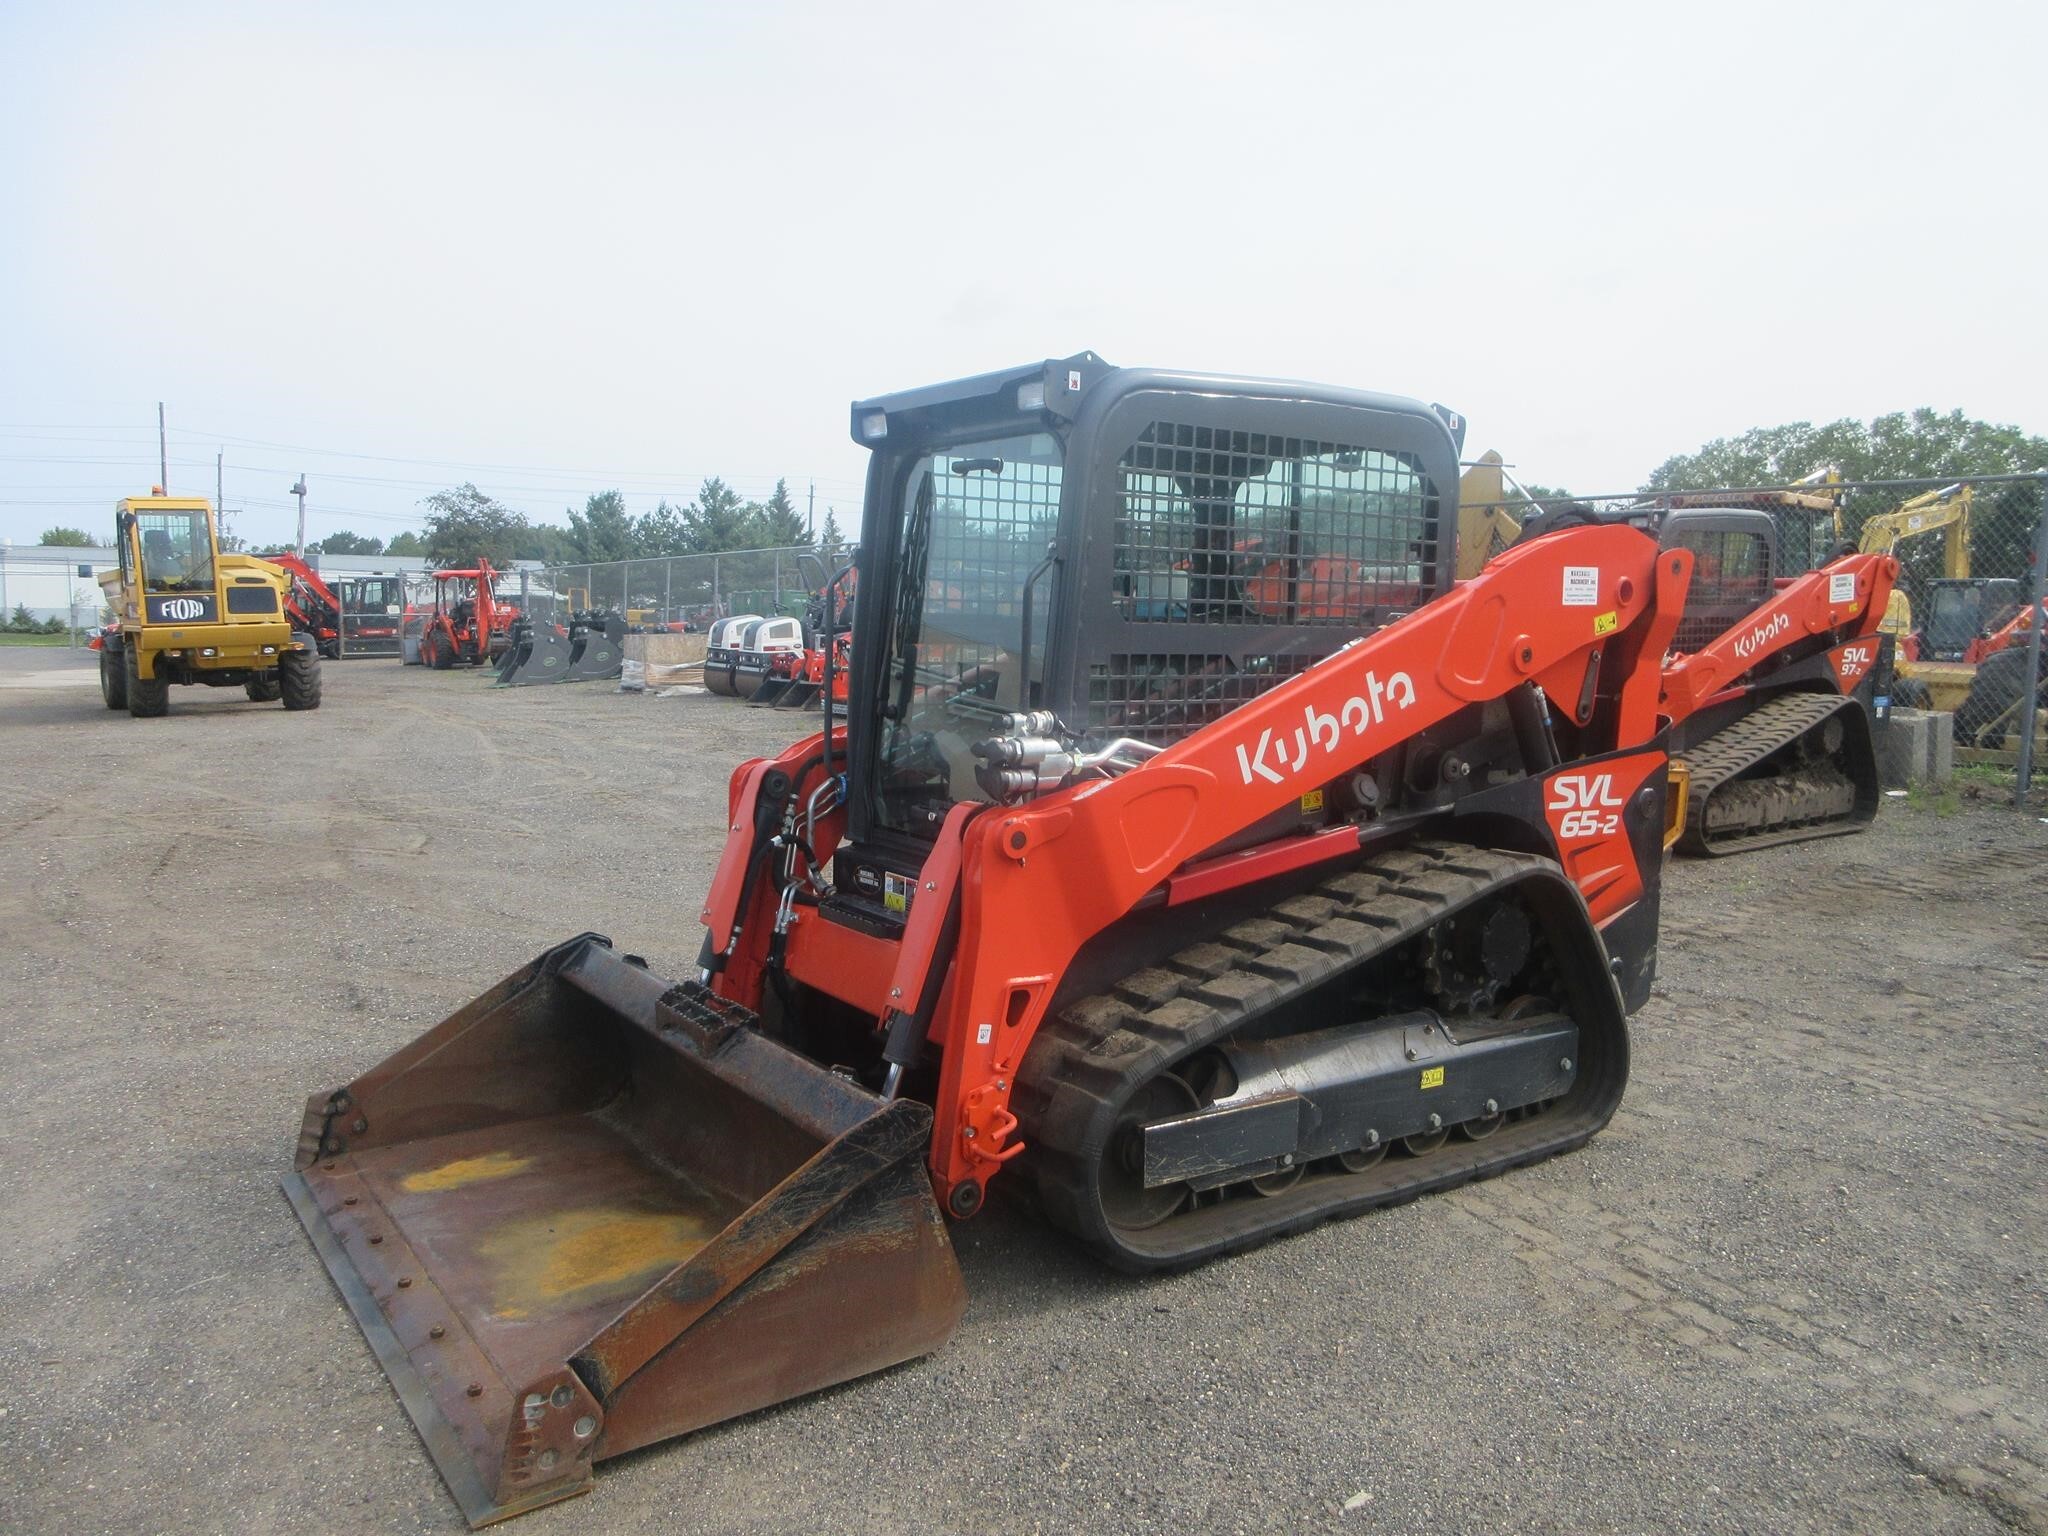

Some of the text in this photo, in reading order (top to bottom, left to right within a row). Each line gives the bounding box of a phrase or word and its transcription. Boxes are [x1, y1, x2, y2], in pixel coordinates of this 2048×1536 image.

[1734, 613, 1790, 657] Kubota
[1840, 663, 1861, 676] 97-2
[1841, 647, 1870, 663] SVL
[1235, 670, 1416, 785] Kubota
[1548, 774, 1623, 810] SVL
[1560, 809, 1619, 838] 65-2
